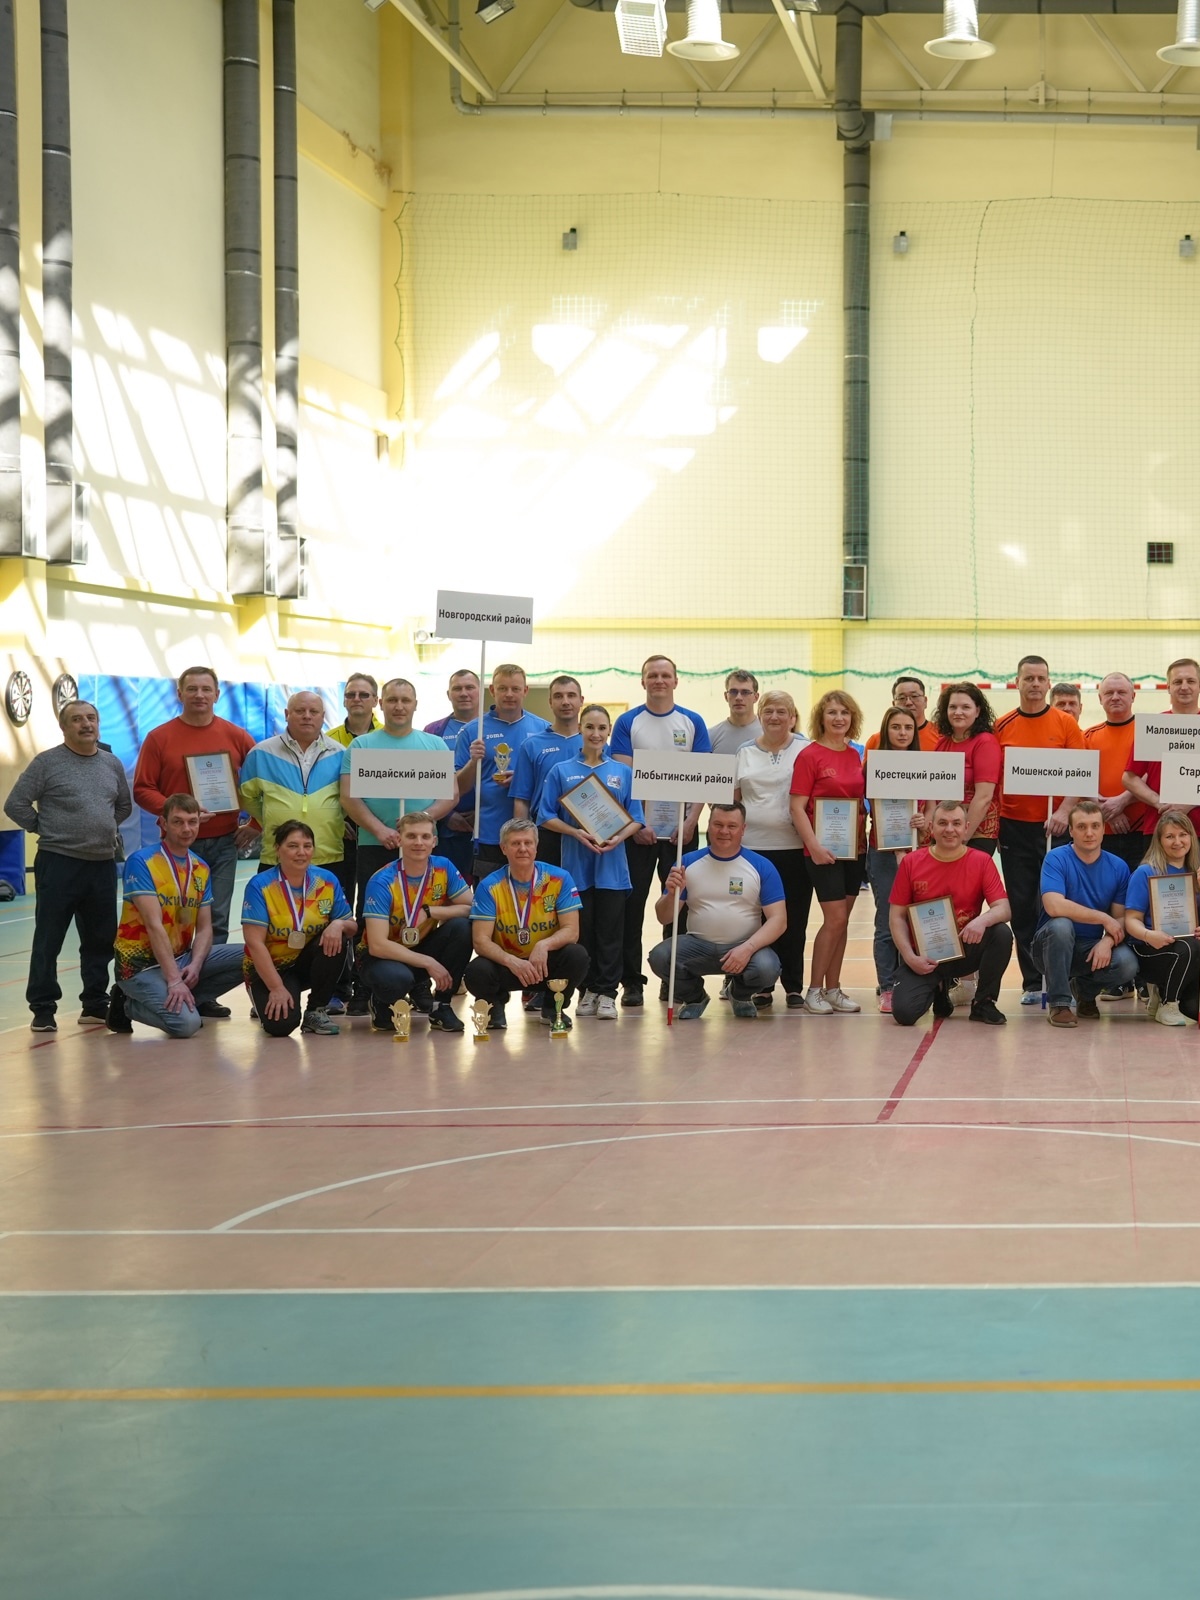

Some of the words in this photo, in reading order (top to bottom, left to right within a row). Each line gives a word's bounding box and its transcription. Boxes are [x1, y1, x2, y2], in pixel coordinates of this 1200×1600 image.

[438, 609, 503, 623] Новгородский
[505, 614, 531, 625] район
[1168, 740, 1196, 752] район
[358, 767, 416, 779] Валдайский
[418, 769, 447, 781] район
[633, 769, 702, 784] Любытинский
[704, 773, 733, 785] район
[875, 769, 927, 781] Крестецкий
[930, 770, 957, 782] район
[1011, 765, 1063, 777] Мошенской
[1066, 767, 1092, 779] район
